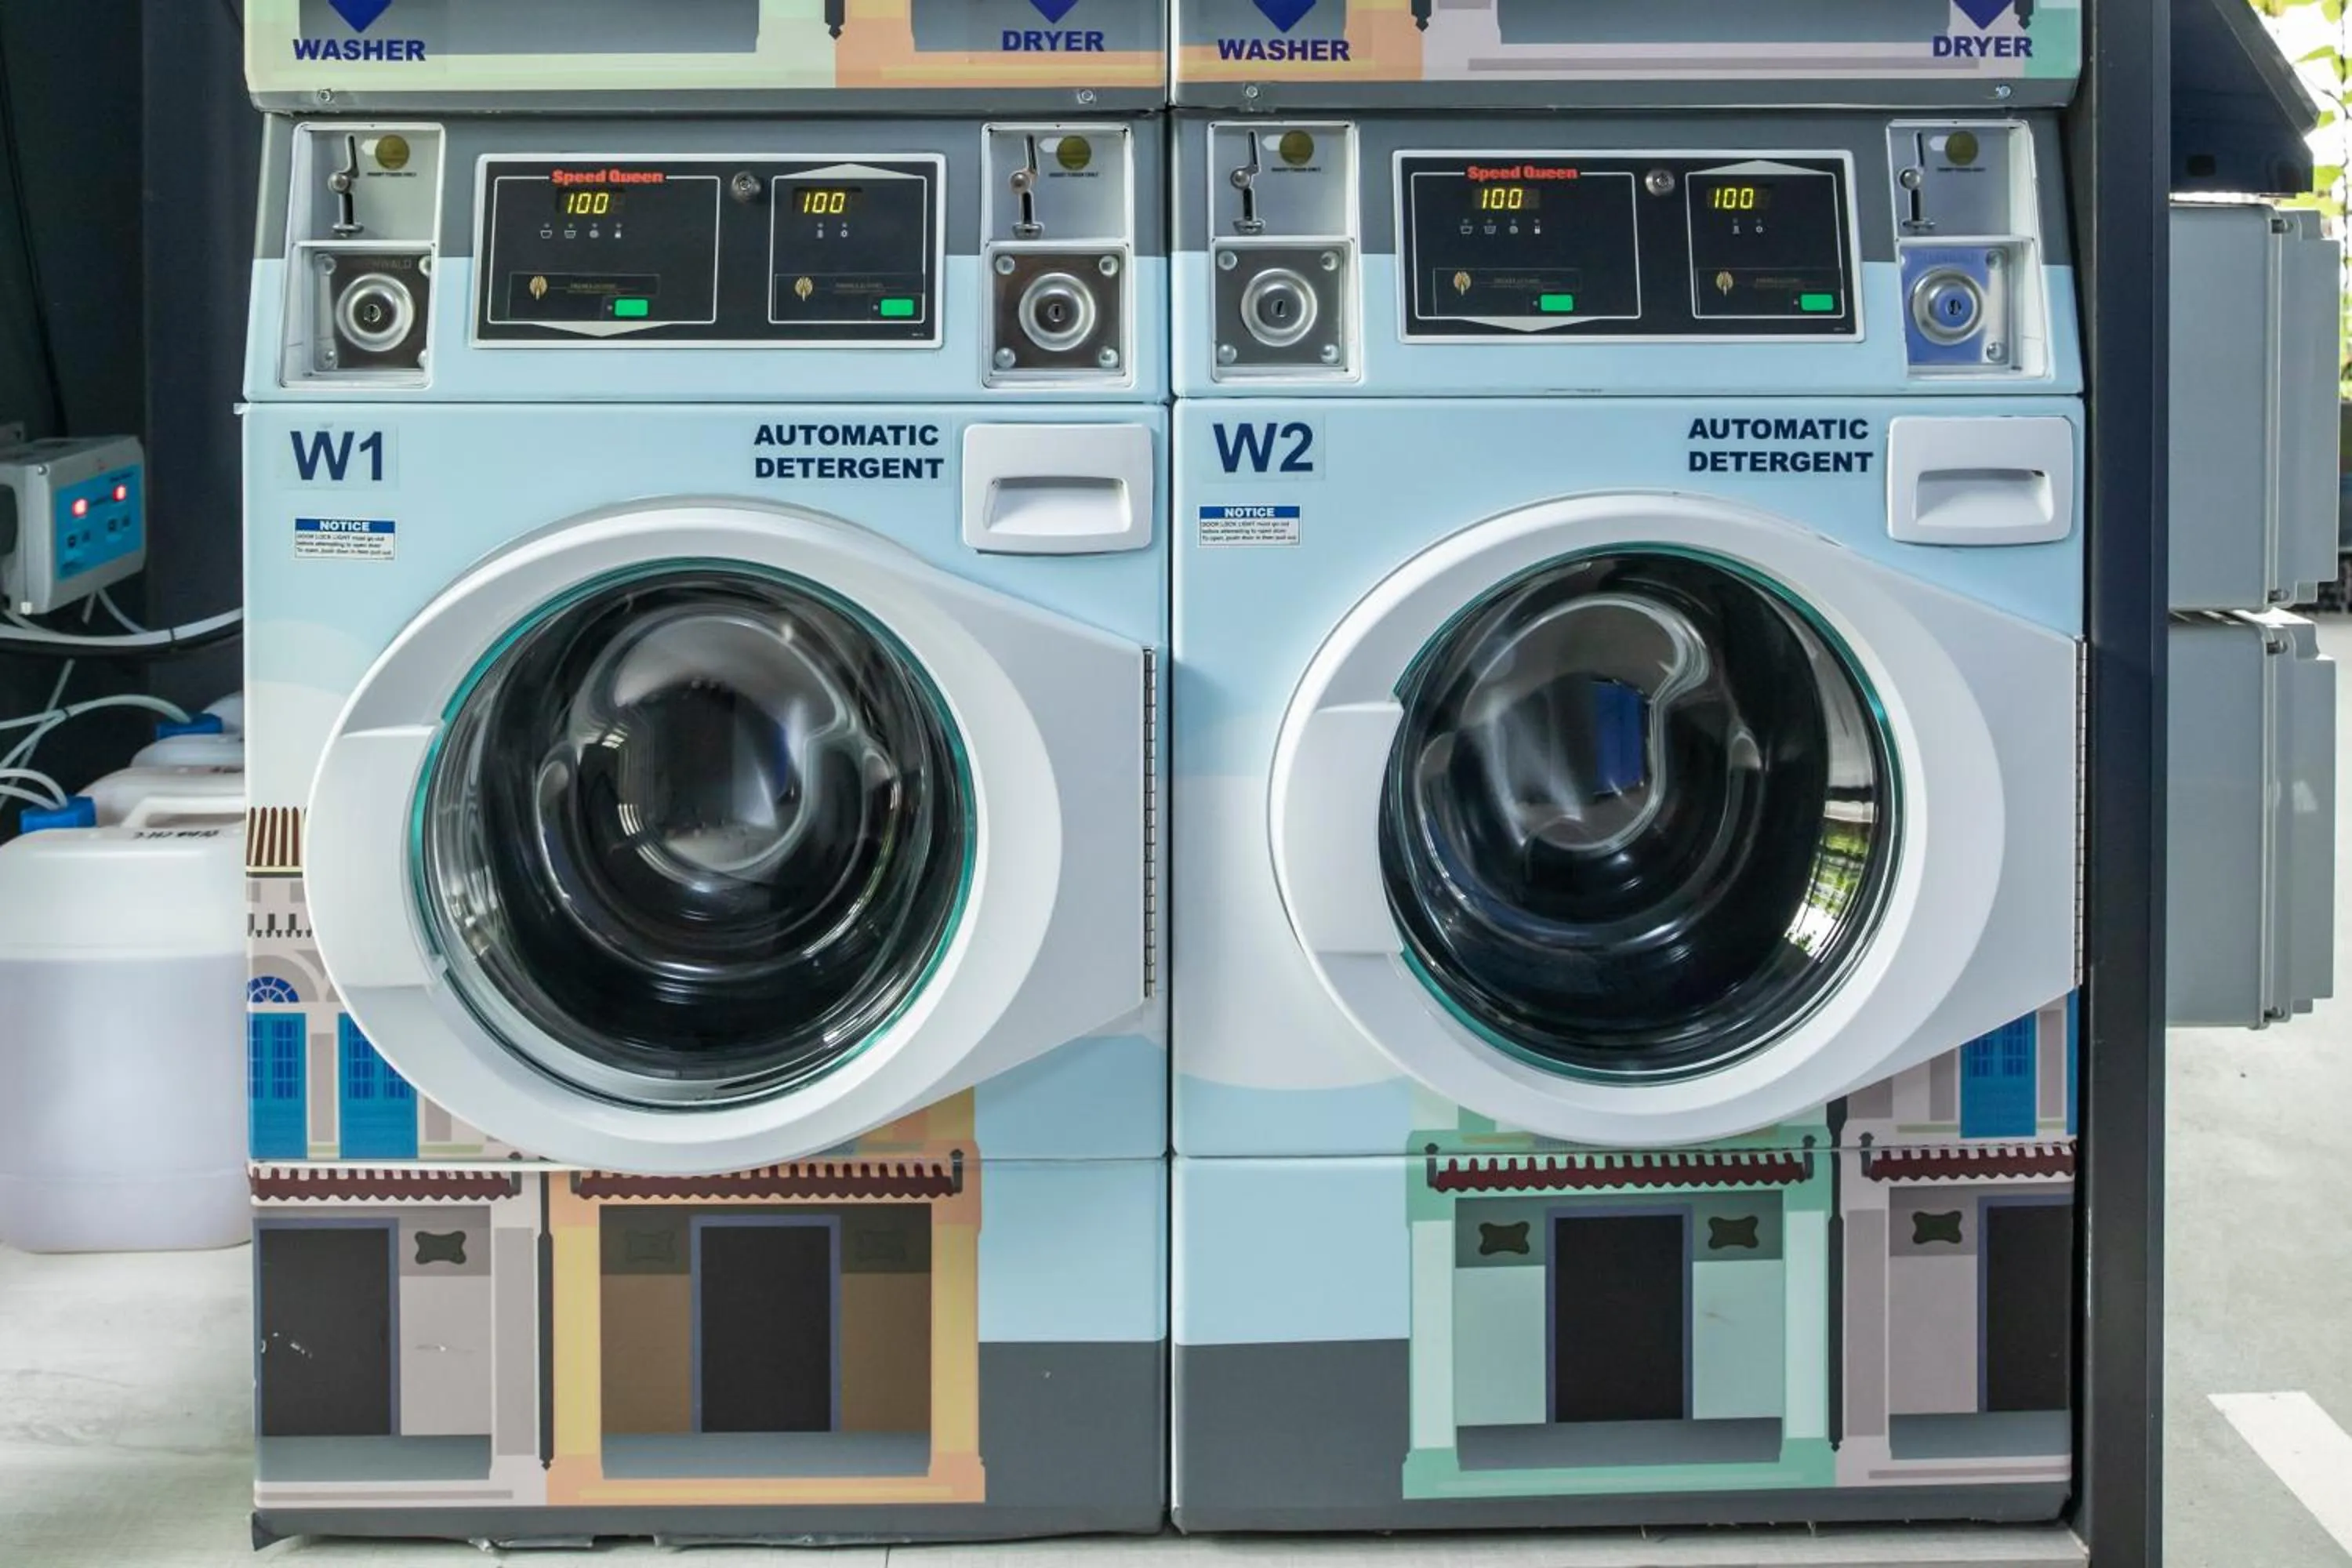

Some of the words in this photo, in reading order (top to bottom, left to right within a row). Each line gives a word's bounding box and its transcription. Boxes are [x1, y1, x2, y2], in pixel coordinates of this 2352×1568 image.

[293, 38, 426, 61] WASHER
[1002, 30, 1105, 52] DRYER
[1218, 38, 1350, 61] WASHER
[1933, 35, 2032, 57] DRYER
[552, 169, 607, 185] Speed
[608, 169, 664, 183] Queen
[1468, 165, 1521, 181] Speed
[1523, 165, 1578, 180] Queen
[567, 192, 609, 214] 100
[804, 192, 845, 214] 100
[1482, 187, 1523, 209] 100
[1715, 187, 1754, 209] 100
[753, 424, 939, 446] AUTOMATIC
[1688, 418, 1869, 440] AUTOMATIC
[289, 430, 383, 481] W1
[1213, 422, 1314, 473] W2
[754, 457, 944, 480] DETERGENT
[1689, 451, 1874, 473] DETERGENT
[1224, 507, 1276, 518] NOTICE
[319, 521, 370, 532] NOTICE
